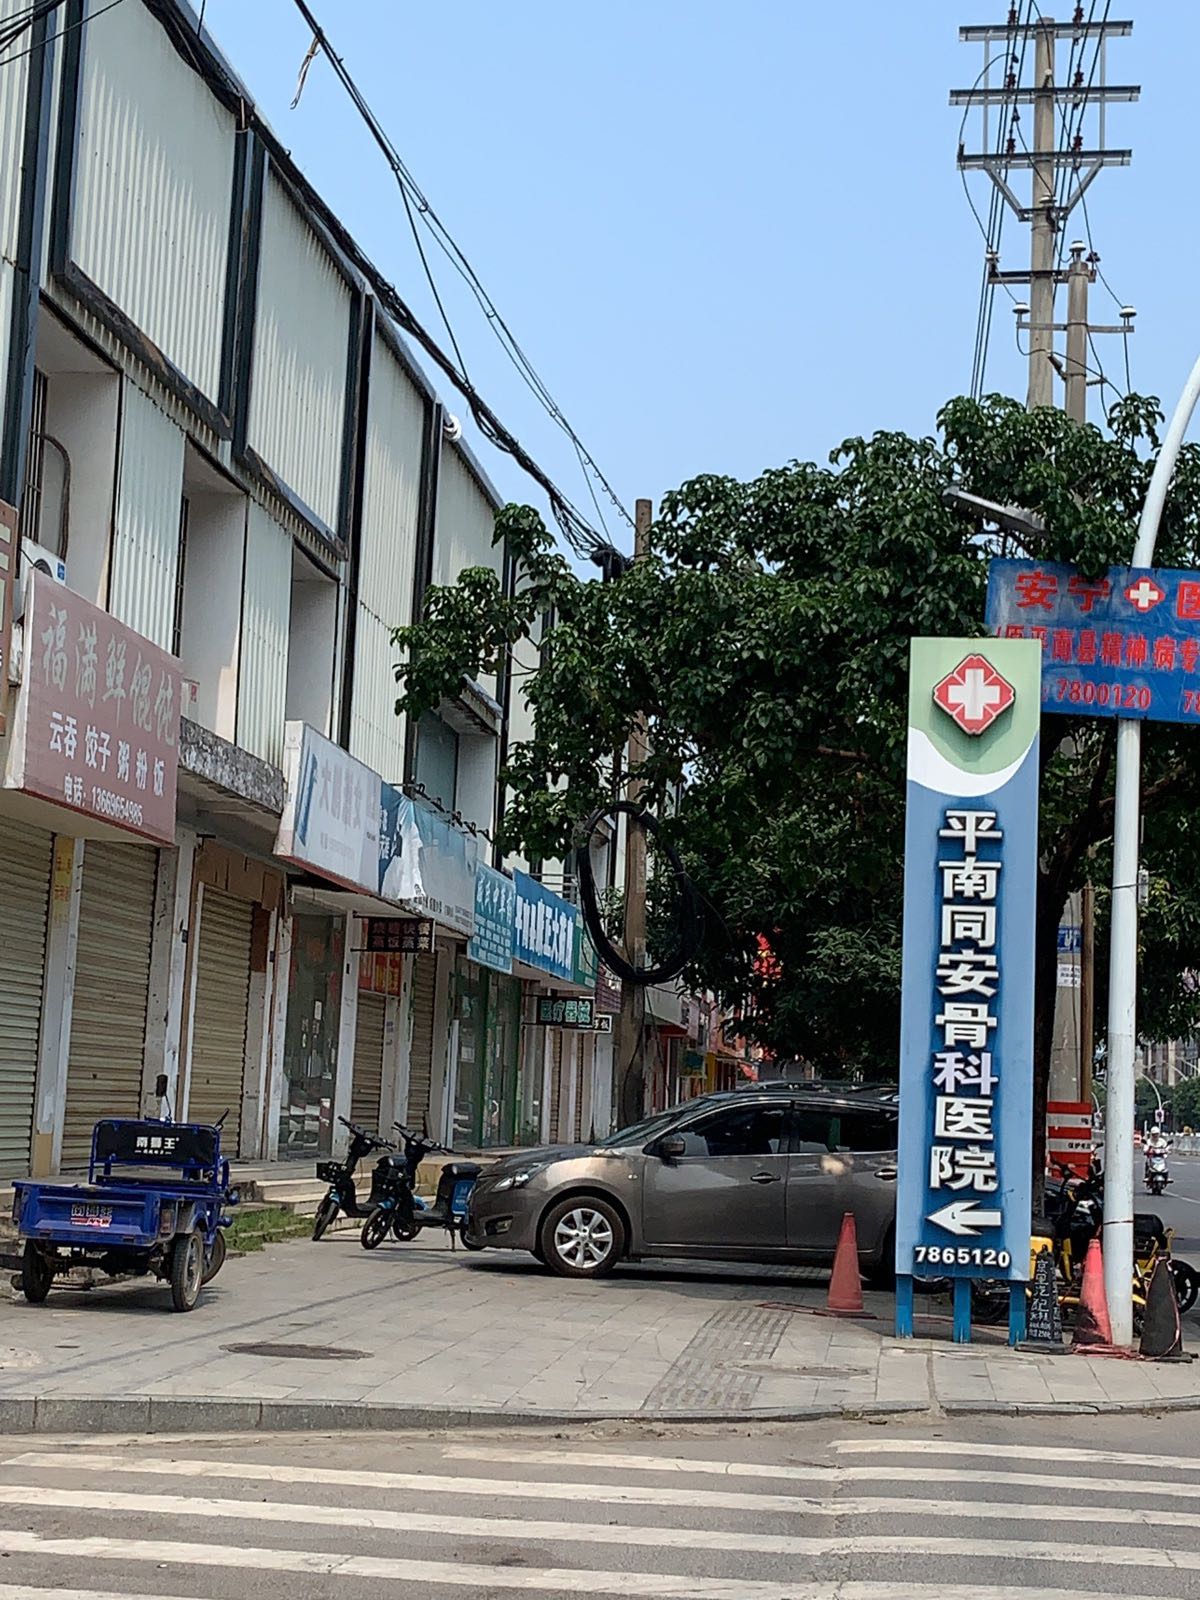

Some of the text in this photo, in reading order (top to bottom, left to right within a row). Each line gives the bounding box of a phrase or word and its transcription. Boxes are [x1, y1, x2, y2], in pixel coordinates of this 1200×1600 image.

[1014, 570, 1111, 612] 安宁
[997, 624, 1200, 673] 南县精神病专
[1056, 678, 1151, 711] 7800120
[50, 711, 77, 760] 云吞
[85, 724, 111, 772] 饺子
[540, 1000, 591, 1024] 医疗器械
[930, 809, 1003, 1193] 平南同安骨科医院
[914, 1246, 1010, 1268] 7865120
